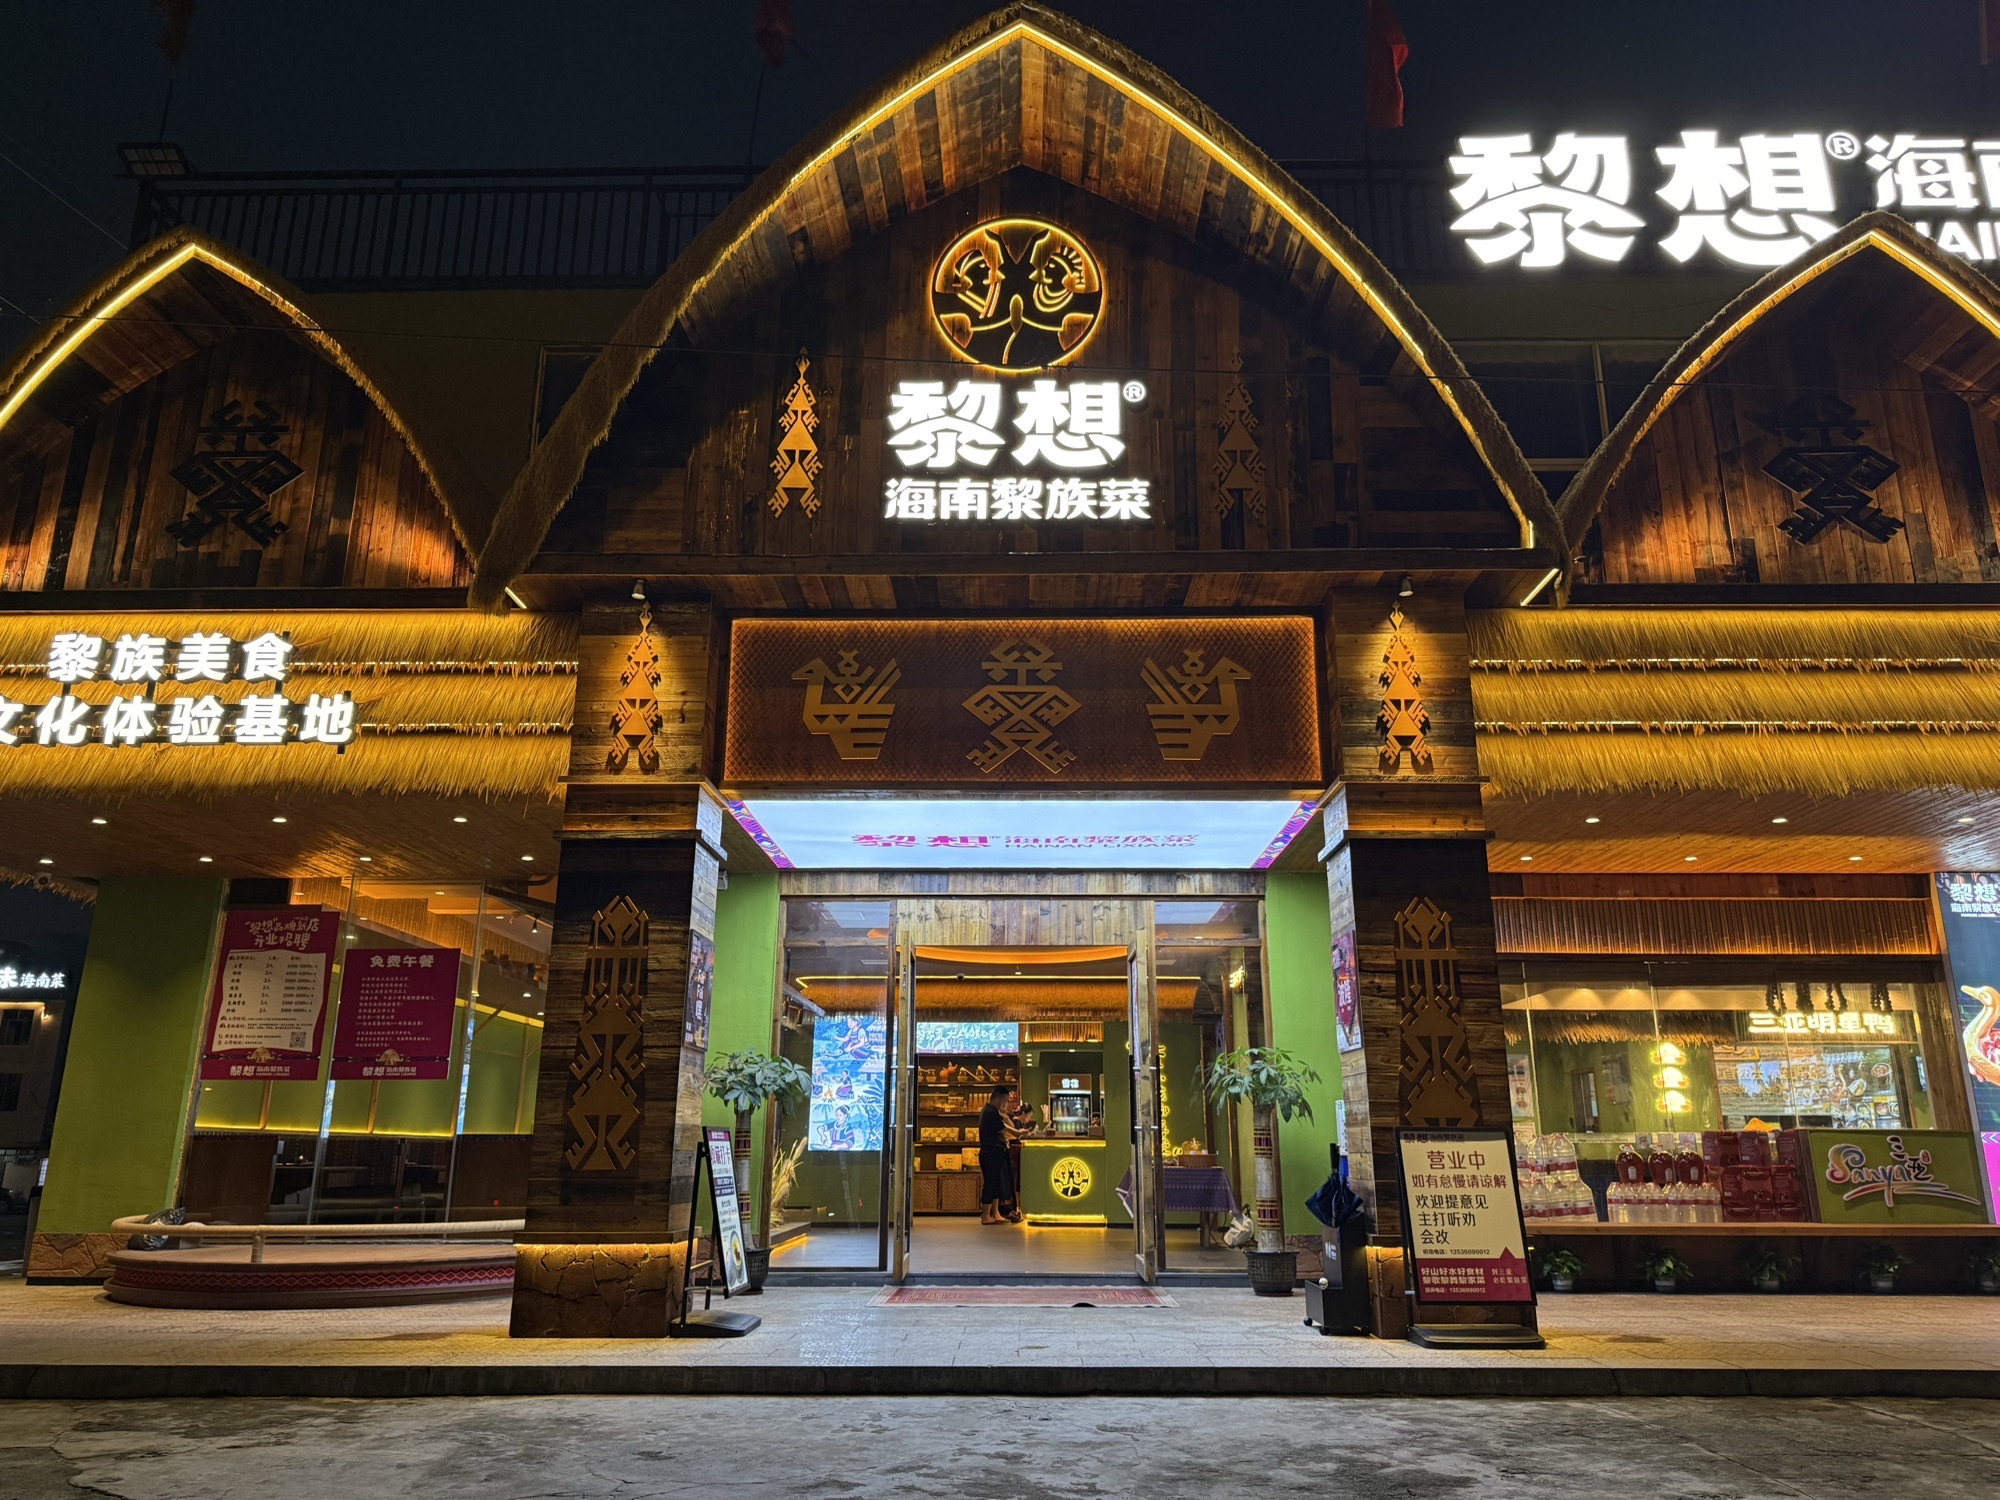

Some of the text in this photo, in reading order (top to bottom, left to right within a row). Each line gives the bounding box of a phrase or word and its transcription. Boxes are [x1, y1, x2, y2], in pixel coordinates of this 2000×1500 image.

[1864, 134, 2000, 208] 海
[885, 478, 1152, 520] 海南黎族菜
[48, 631, 294, 683] 黎族美食
[370, 954, 434, 968] 免费午餐
[20, 972, 66, 989] 海南菜
[1748, 1011, 1895, 1034] 三亚明星鸭
[1426, 1150, 1485, 1171] 营业中
[1411, 1174, 1508, 1189] 如有怠慢请谅解
[1415, 1194, 1489, 1210] 欢迎提意见
[1417, 1212, 1476, 1227] 主打听劝
[1420, 1229, 1450, 1246] 会改
[1421, 1267, 1484, 1276] 好山好水好食材
